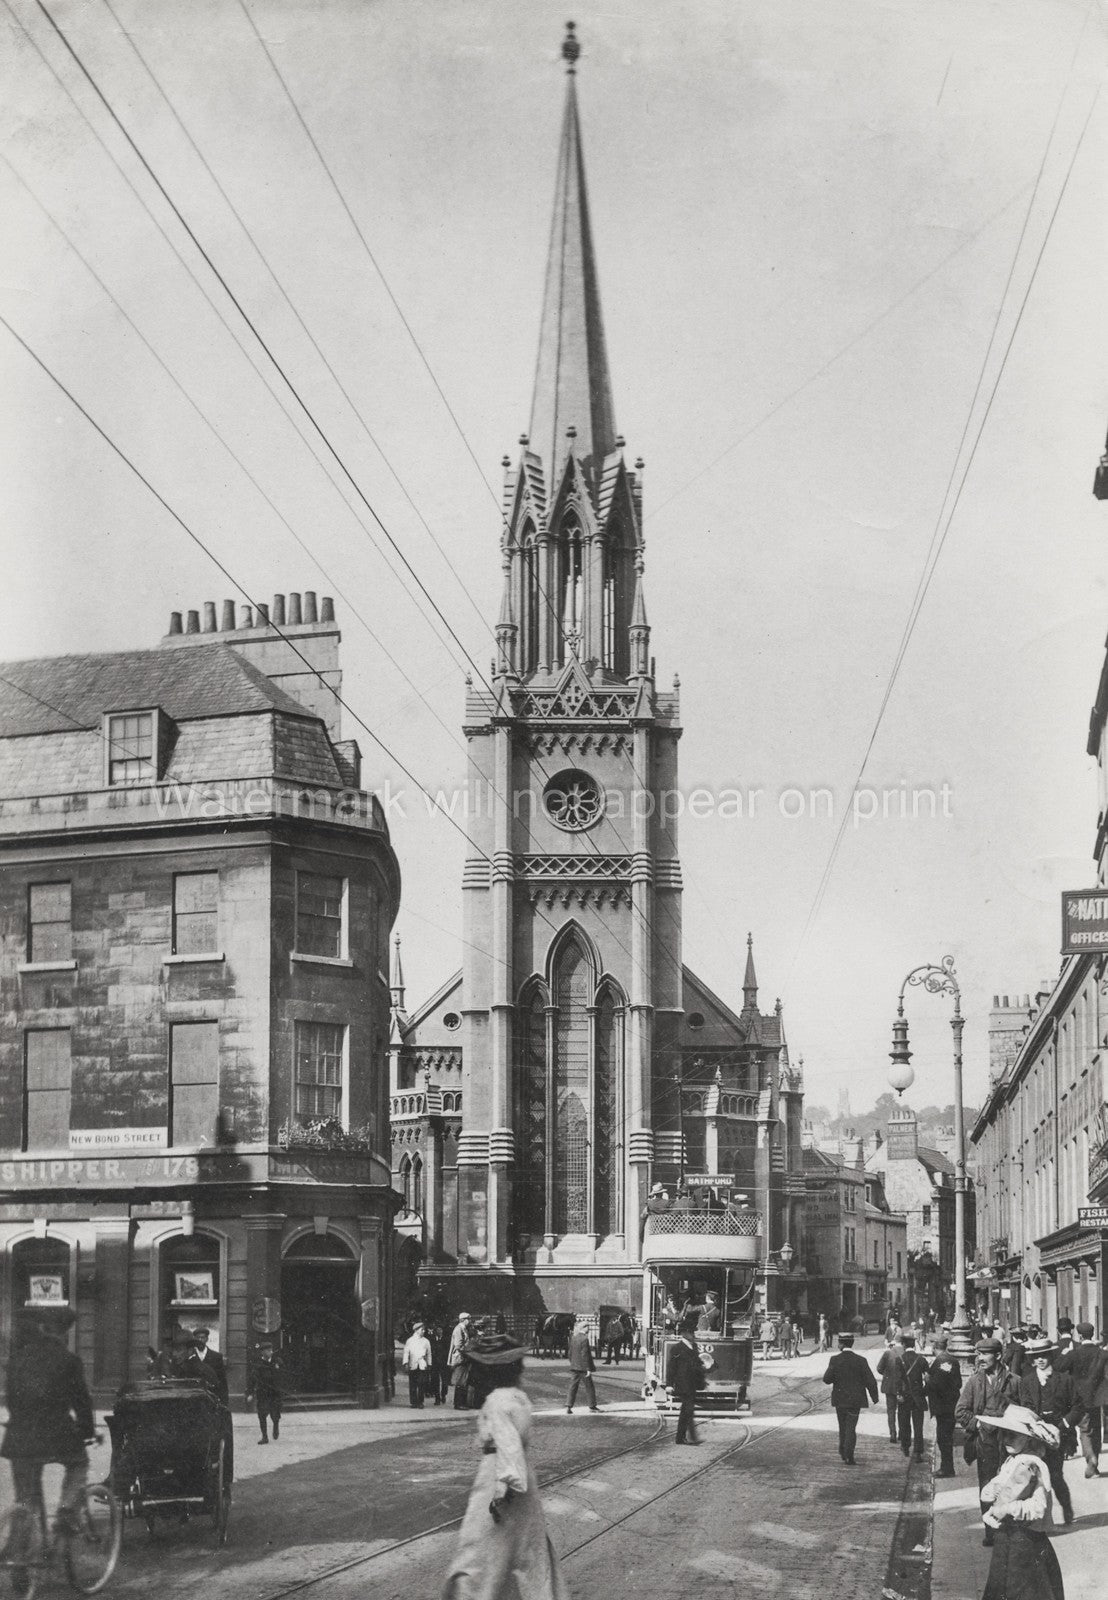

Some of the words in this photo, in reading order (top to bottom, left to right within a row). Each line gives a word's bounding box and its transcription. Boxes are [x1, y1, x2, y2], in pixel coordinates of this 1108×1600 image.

[71, 1135, 92, 1144] NEW
[94, 1134, 120, 1144] BOND
[123, 1133, 161, 1143] STREET
[1, 1158, 126, 1182] SHIPPER.
[688, 1177, 733, 1185] BATHFORD
[1080, 1209, 1107, 1218] FISH
